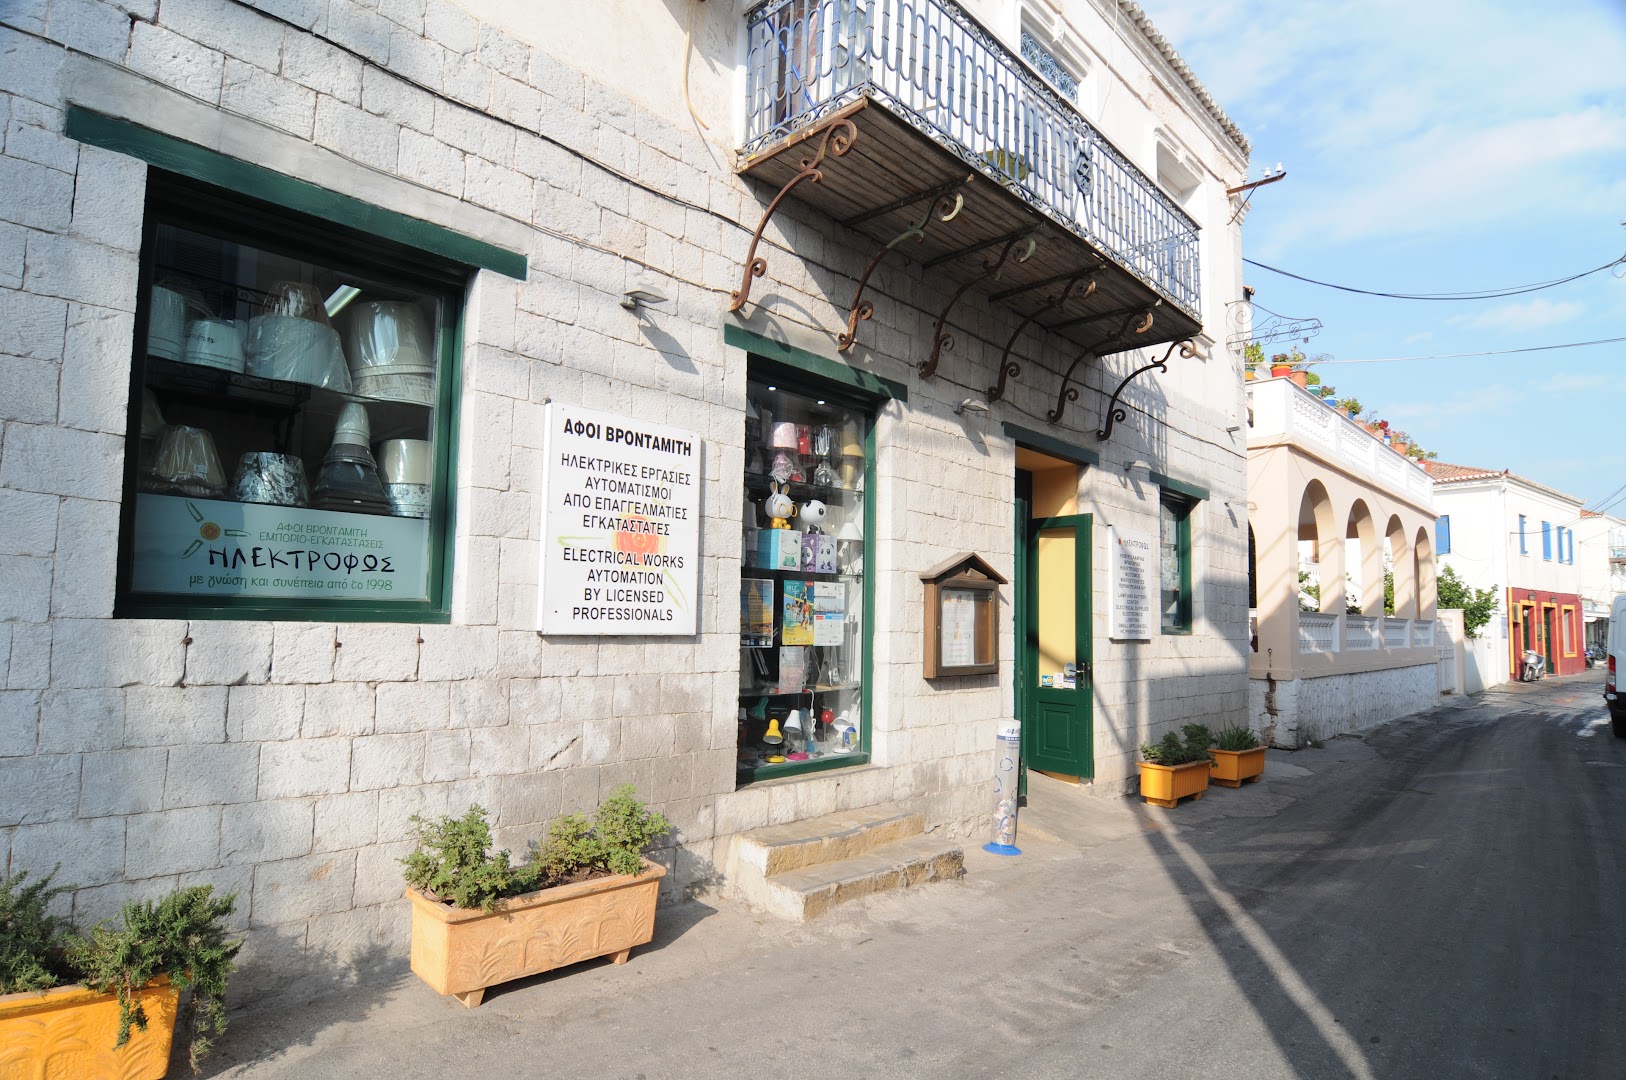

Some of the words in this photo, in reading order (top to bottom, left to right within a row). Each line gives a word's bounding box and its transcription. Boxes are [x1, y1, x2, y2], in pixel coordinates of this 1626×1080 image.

[564, 418, 601, 440] ΑΦΟΙ
[605, 426, 692, 457] ΒΡΟΝΤΑΜΙΤΗ
[561, 453, 638, 477] ΗΛΕΚΤΡΙΚΕΣ
[641, 466, 691, 486] ΕΡΓΑΣΙΕΣ
[585, 476, 672, 500] ΑΥΤΟΜΑΤΙΣΜΟΙ
[563, 493, 591, 508] ΑΠΟ
[595, 496, 688, 520] ΕΠΑΓΓΕΛΜΑΤΙΕΣ
[276, 522, 304, 533] ΑΦΟΙ
[306, 524, 368, 538] ΒΡΟΝΤΑΜΙΤΗ
[583, 514, 671, 536] ΕΓΚΑΤΑΣΤΑΤΕΣ
[208, 544, 395, 575] ΗΛΕΚΤΡΟΦΩΣ
[563, 547, 640, 566] ELECTRICAL
[642, 553, 684, 569] WORKS
[189, 575, 204, 587] με
[208, 573, 247, 590] γνώση
[251, 577, 269, 587] και
[272, 576, 324, 589] συνέπεια
[327, 578, 348, 590] από
[351, 580, 363, 589] το
[366, 579, 393, 591] 1998
[584, 588, 601, 601] BY
[606, 589, 664, 603] LICENSED
[572, 607, 673, 622] PROFESSIONALS
